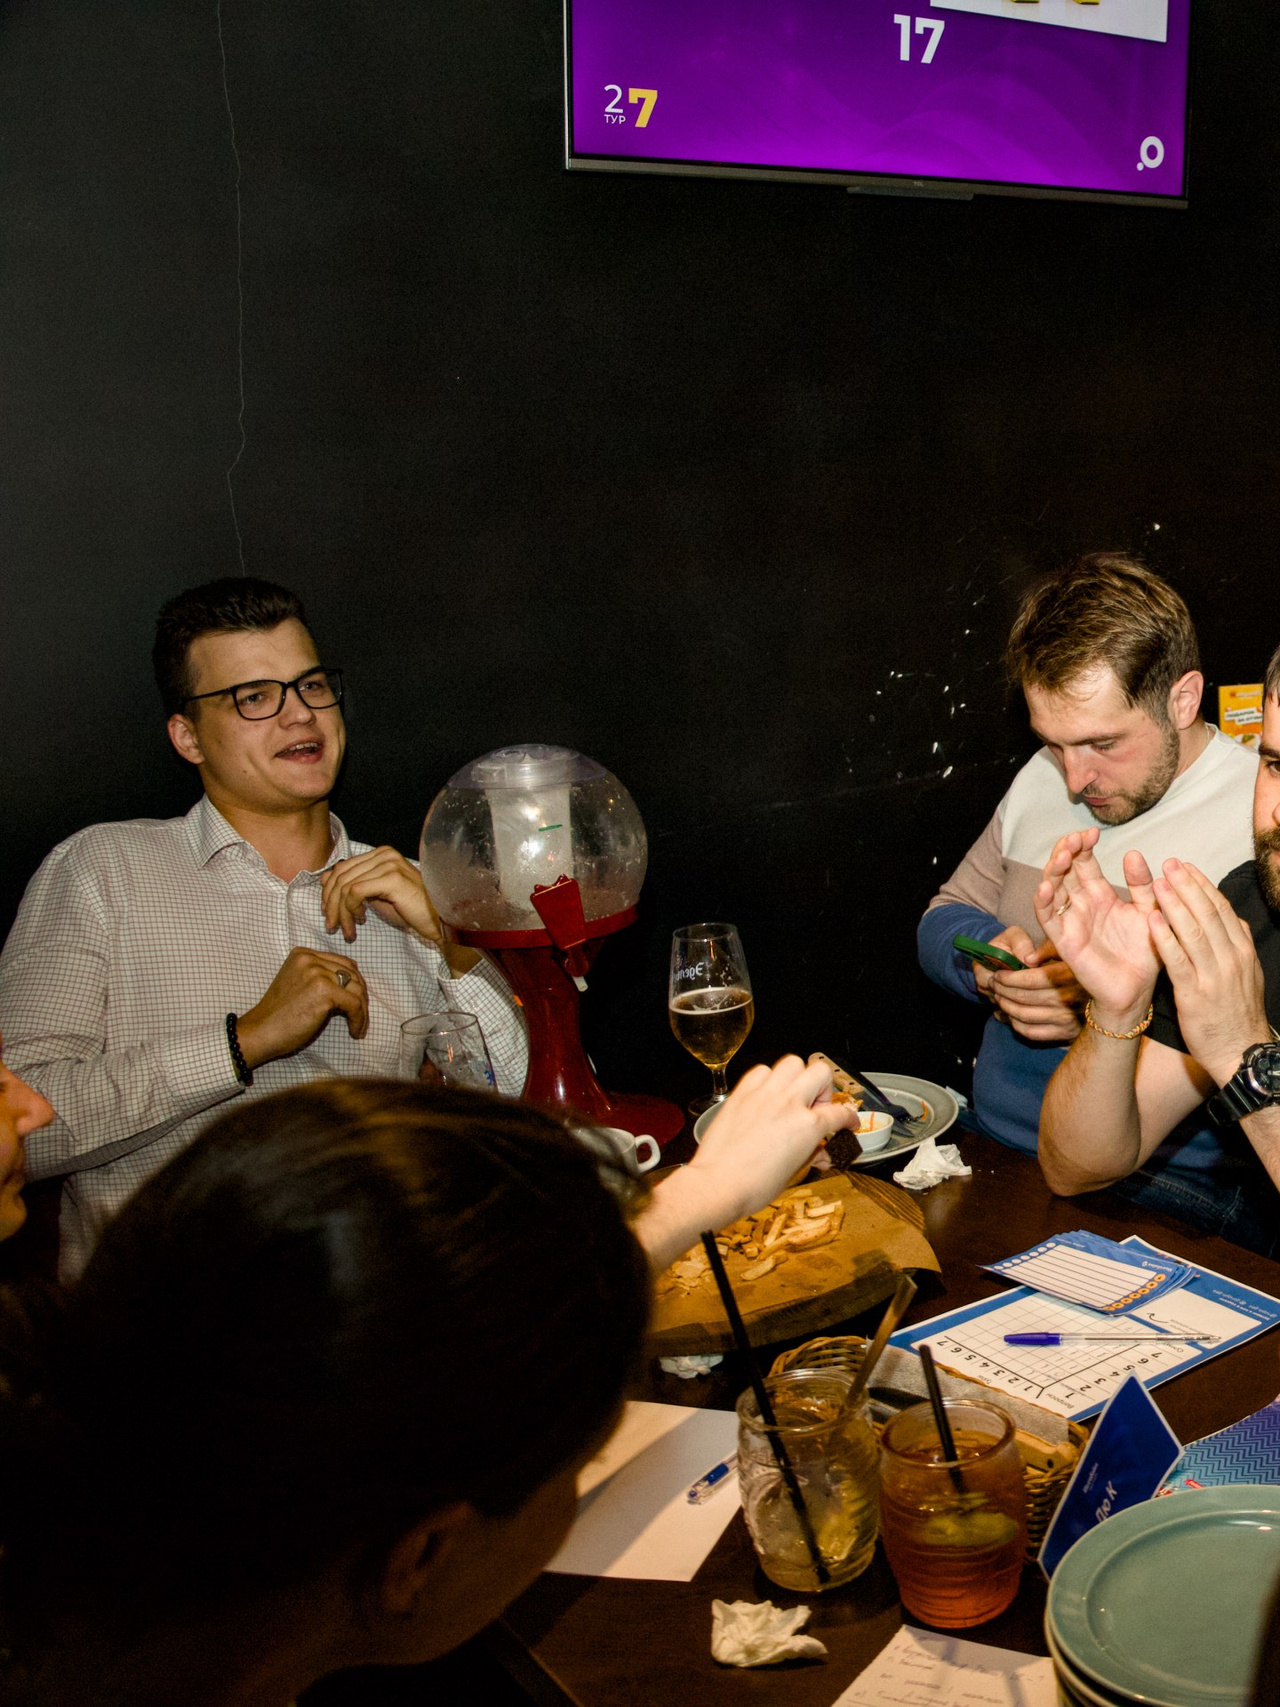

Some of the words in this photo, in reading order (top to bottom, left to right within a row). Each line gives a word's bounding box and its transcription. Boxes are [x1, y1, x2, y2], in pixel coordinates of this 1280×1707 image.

[894, 13, 945, 64] 17
[604, 84, 623, 113] 2
[628, 87, 658, 128] 7
[604, 114, 626, 124] ТУР
[1094, 1377, 1107, 1385] 3
